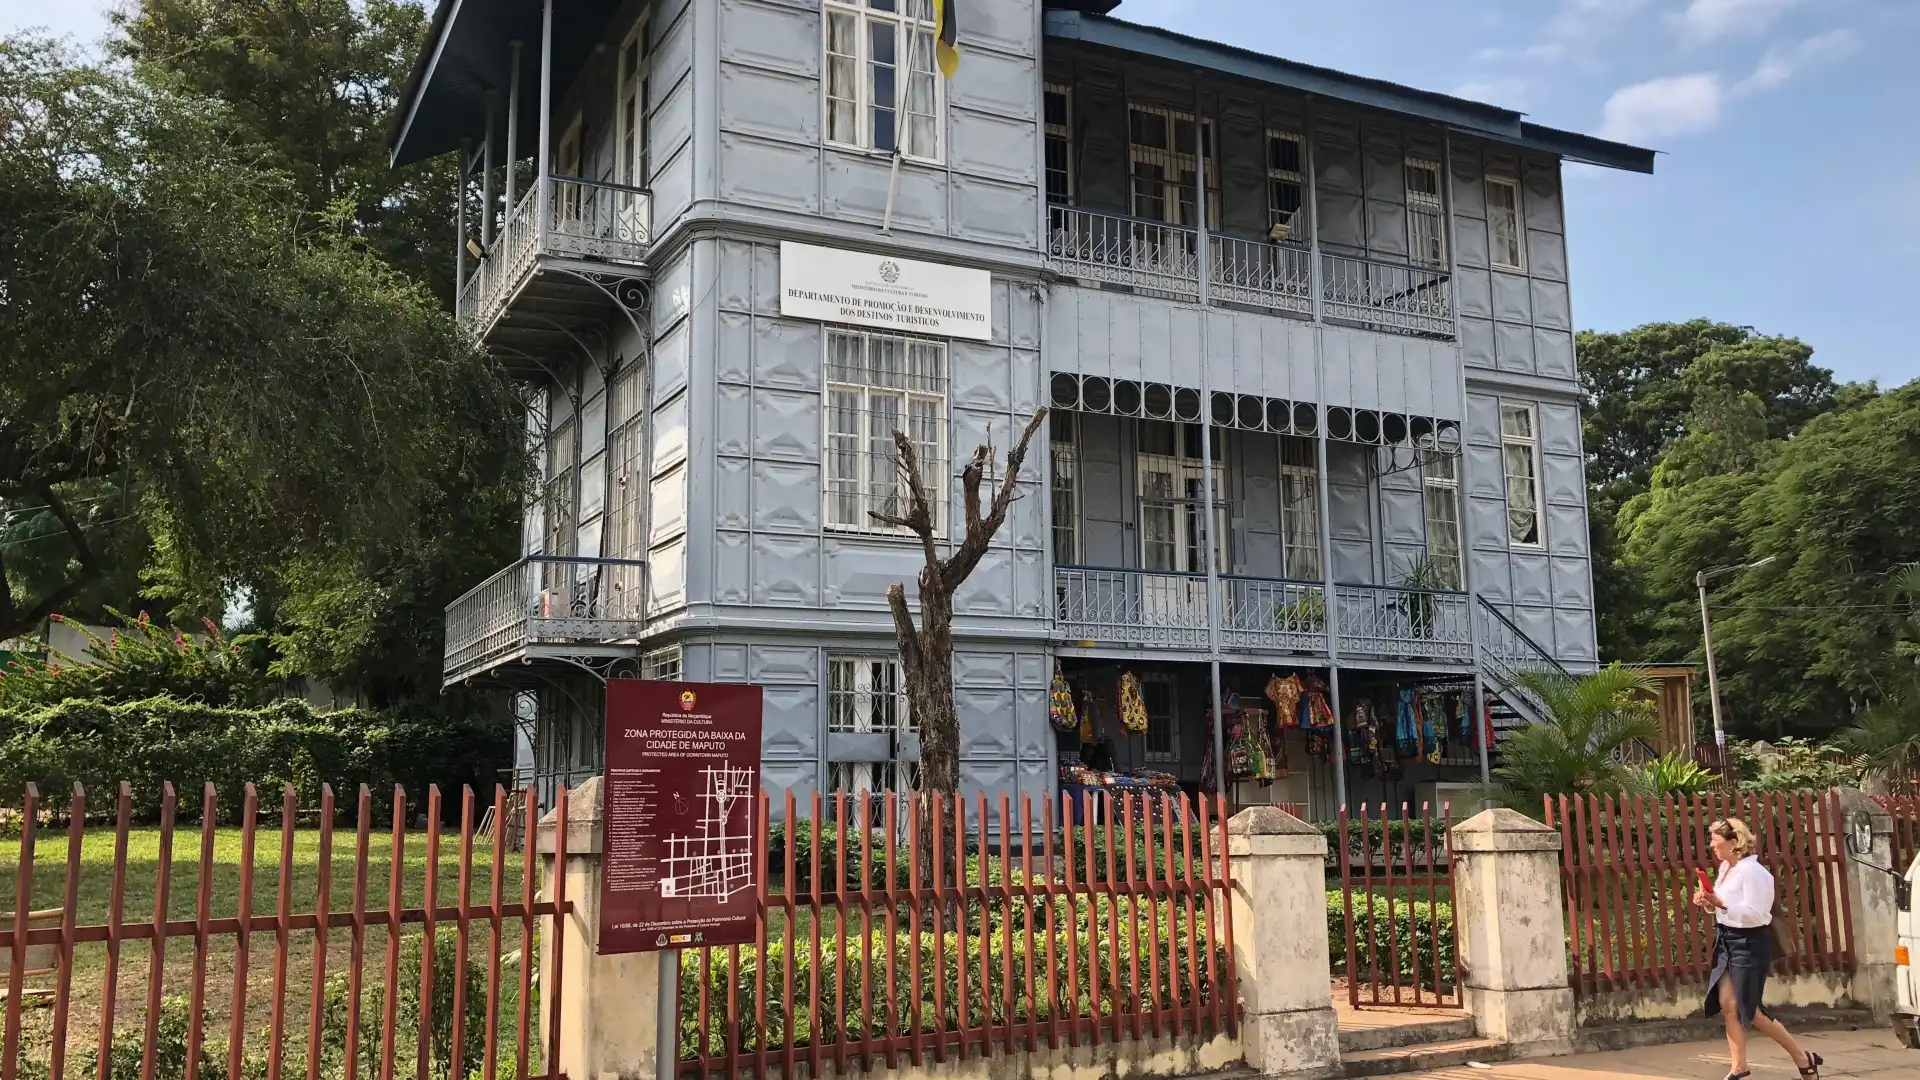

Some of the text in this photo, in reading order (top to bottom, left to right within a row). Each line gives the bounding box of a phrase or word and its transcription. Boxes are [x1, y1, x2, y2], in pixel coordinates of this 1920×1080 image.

[788, 288, 985, 322] DEPARTAMENTO DE PROMOÇÃO E DESENVOLVIMENTO
[840, 308, 856, 316] DOS
[857, 310, 893, 321] DESTINOS
[624, 729, 746, 740] ZONA PROTEGIDA DA BAIXA DA
[646, 740, 726, 750] CIDADE DE MAPUTO
